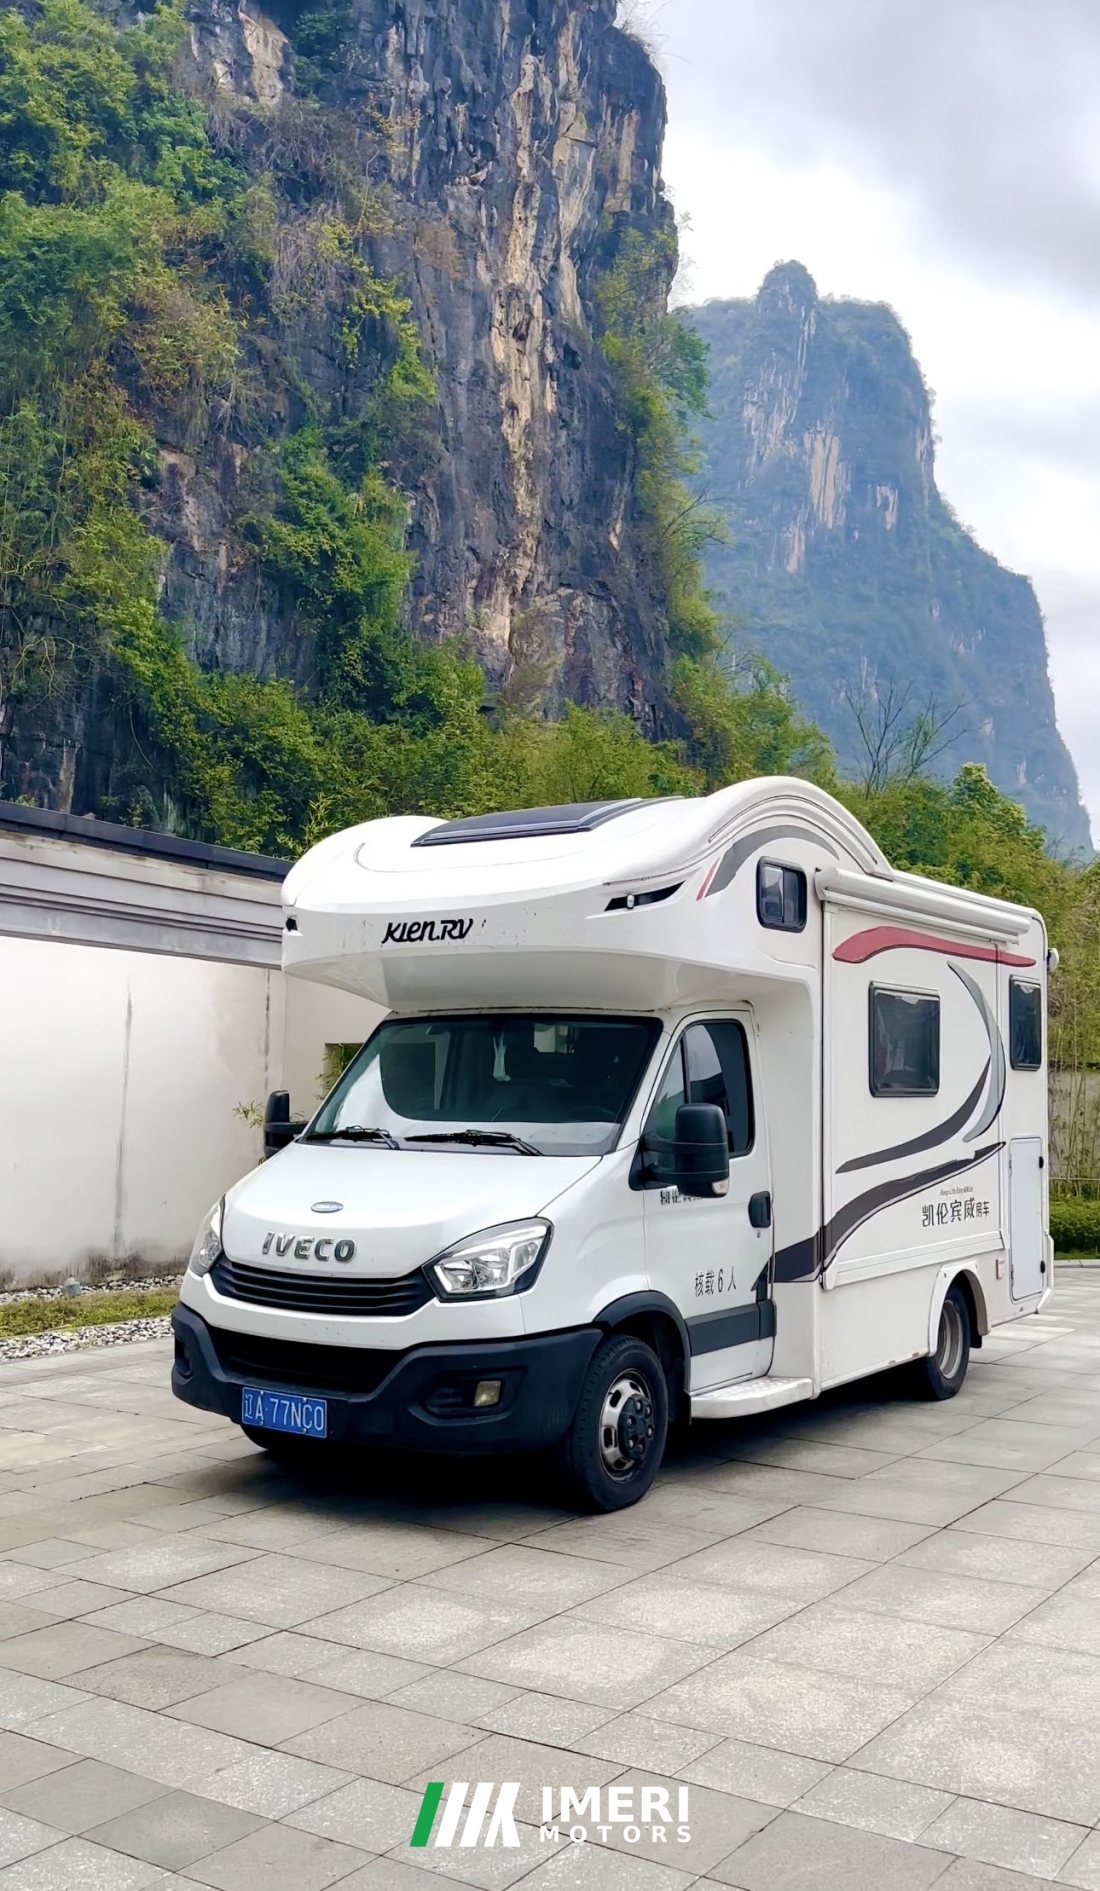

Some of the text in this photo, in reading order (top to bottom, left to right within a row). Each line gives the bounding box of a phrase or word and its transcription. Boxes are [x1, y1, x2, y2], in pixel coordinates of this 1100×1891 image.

[922, 1197, 990, 1227] 凯伦宾威房车
[262, 1232, 356, 1263] IVECO
